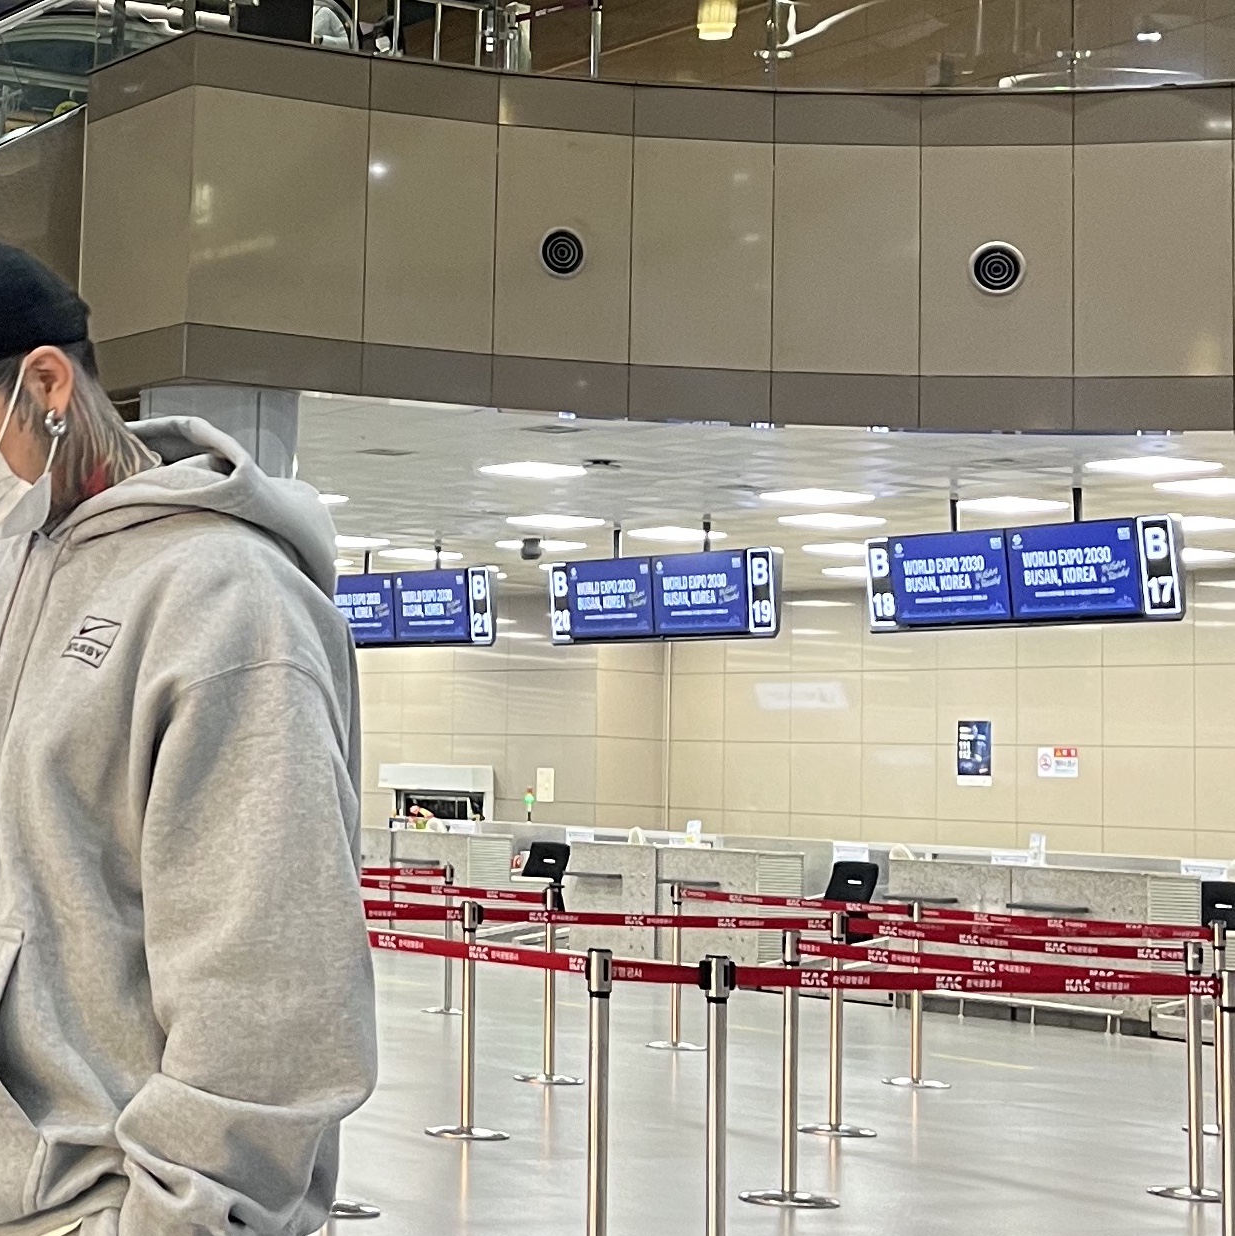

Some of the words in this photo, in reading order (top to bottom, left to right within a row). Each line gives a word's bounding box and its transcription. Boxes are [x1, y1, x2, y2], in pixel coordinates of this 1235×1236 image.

[1144, 526, 1168, 560] B
[870, 547, 889, 577] B
[903, 559, 935, 576] WORLD
[936, 557, 959, 574] EXPO
[960, 555, 984, 572] 2030
[1022, 550, 1057, 568] WORLD
[1058, 548, 1083, 566] EXPO
[1084, 546, 1111, 564] 2030
[752, 557, 769, 586] B
[940, 573, 972, 591] KOREA
[1062, 566, 1097, 584] KOREA
[472, 575, 486, 599] B
[553, 571, 568, 597] B
[1147, 577, 1173, 603] 17
[753, 600, 771, 623] 19
[872, 592, 895, 617] 18
[473, 613, 489, 633] 21
[867, 949, 889, 963] KAC
[973, 960, 996, 974] KAC
[801, 971, 828, 986] KAC
[935, 975, 962, 990] KAC
[1065, 979, 1091, 992] KAC
[1190, 980, 1215, 994] KAC
